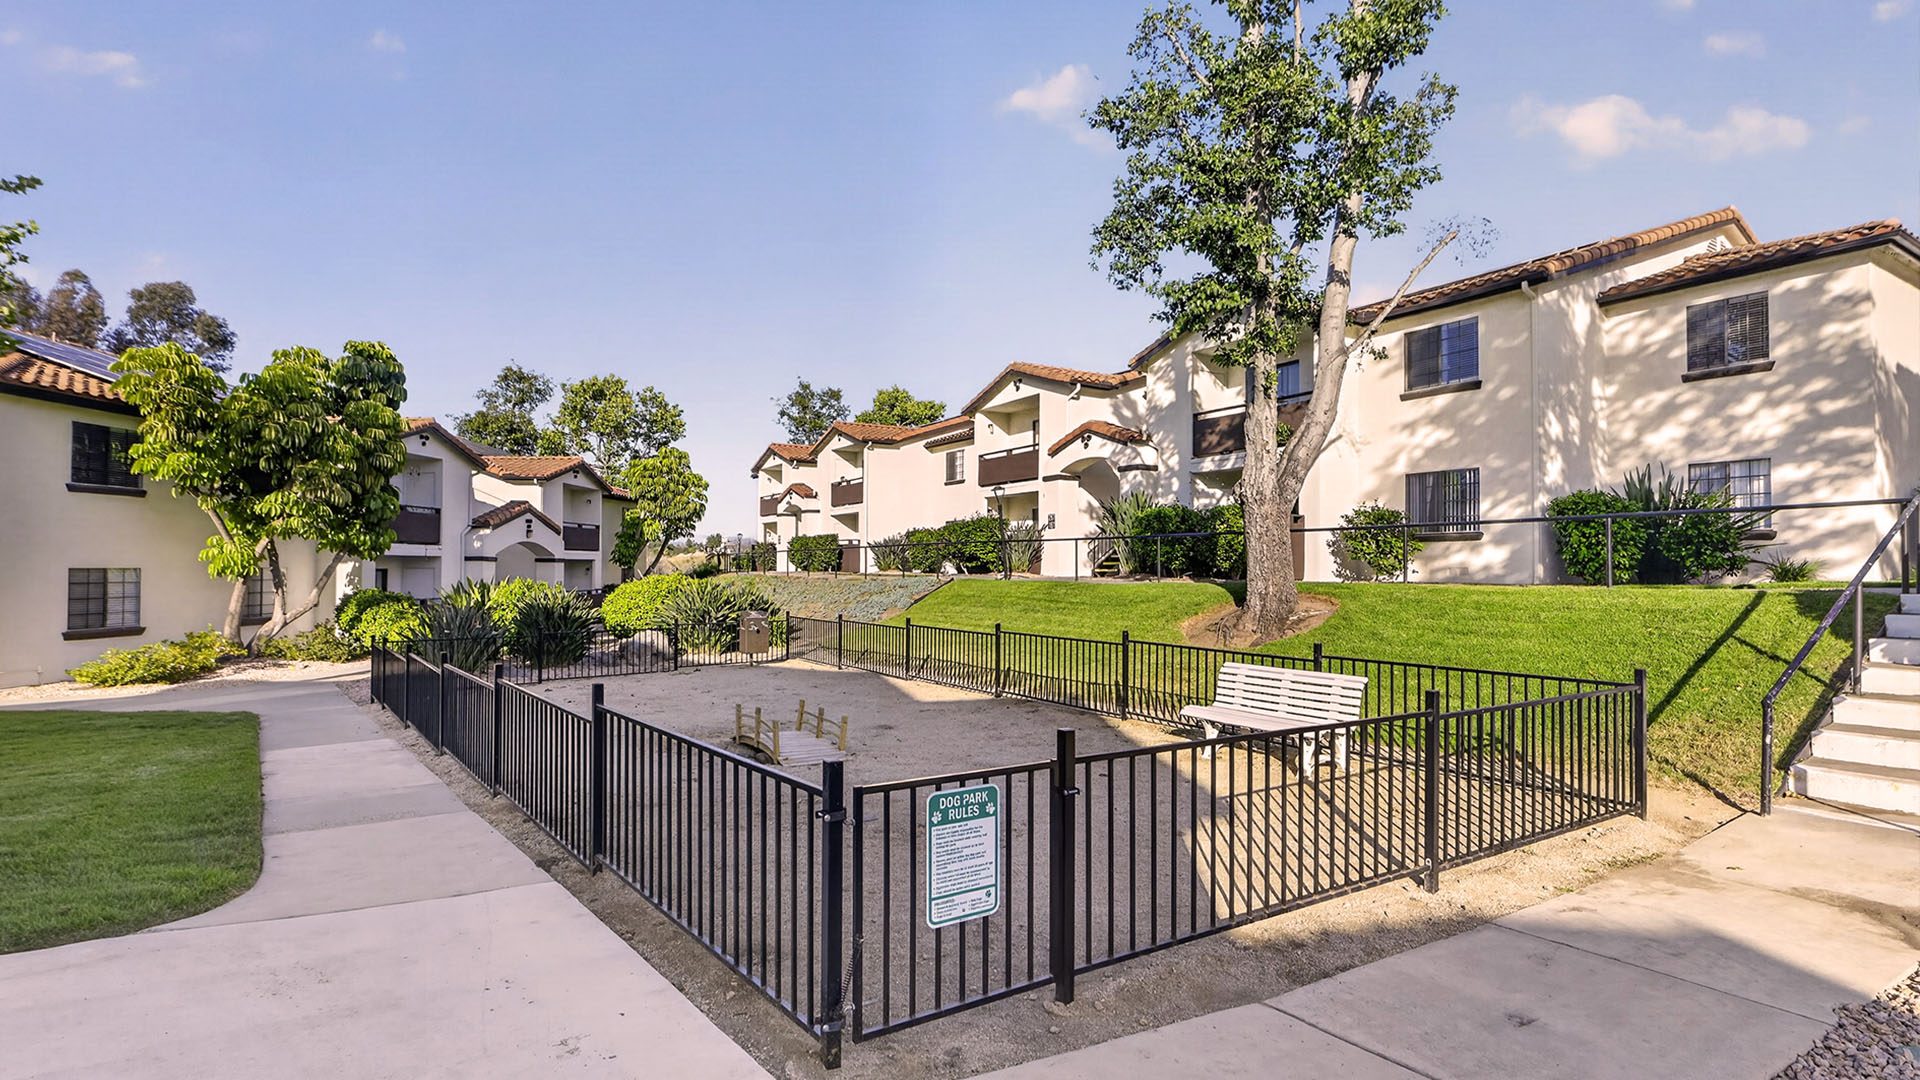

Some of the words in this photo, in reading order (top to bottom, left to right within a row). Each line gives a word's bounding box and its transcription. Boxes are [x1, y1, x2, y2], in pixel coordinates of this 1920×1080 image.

[939, 795, 961, 809] DOG
[963, 791, 989, 806] PARK
[948, 805, 980, 820] RULES
